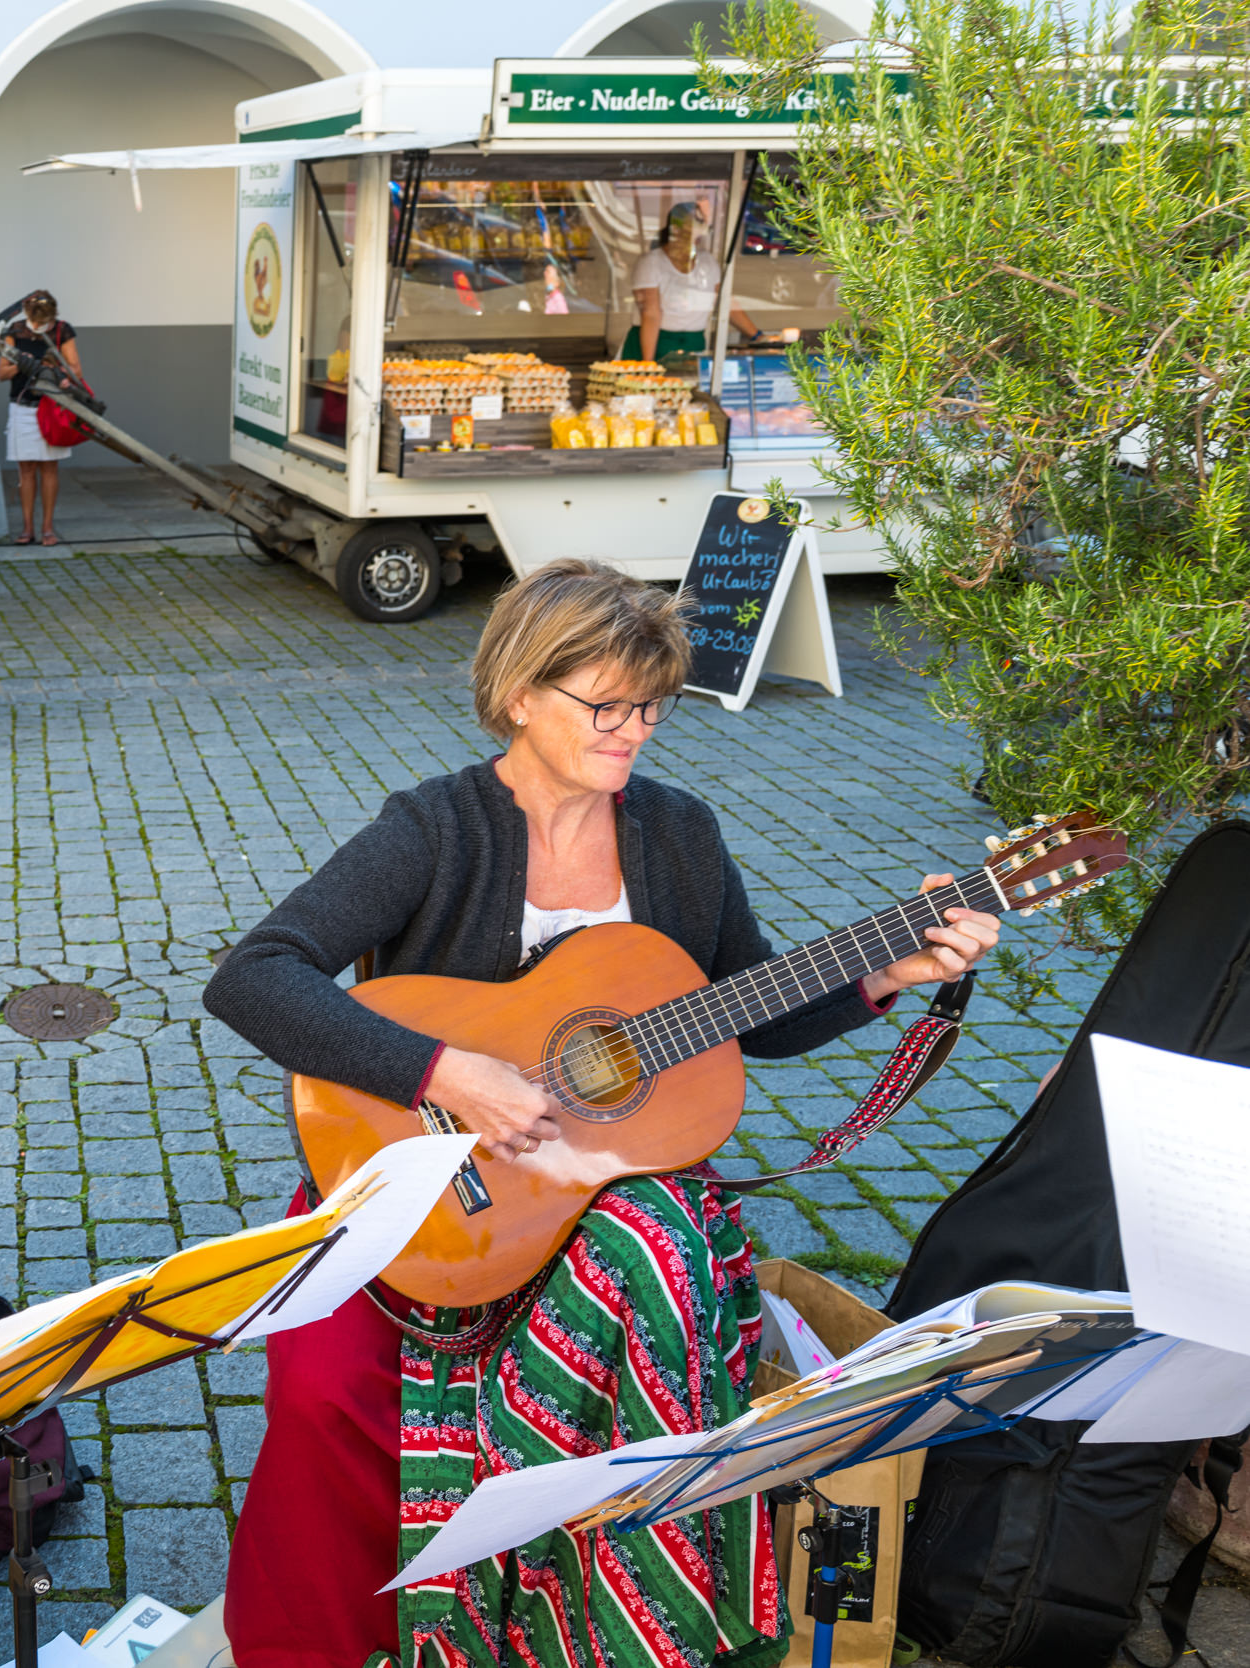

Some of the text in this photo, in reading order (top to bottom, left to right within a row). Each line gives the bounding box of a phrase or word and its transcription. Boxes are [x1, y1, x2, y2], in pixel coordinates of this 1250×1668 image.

[529, 88, 575, 112] Eier
[590, 87, 668, 112] Nudeln
[238, 351, 282, 385] direkt vom
[717, 523, 762, 547] Wir
[698, 547, 780, 569] machen
[699, 602, 731, 615] vom
